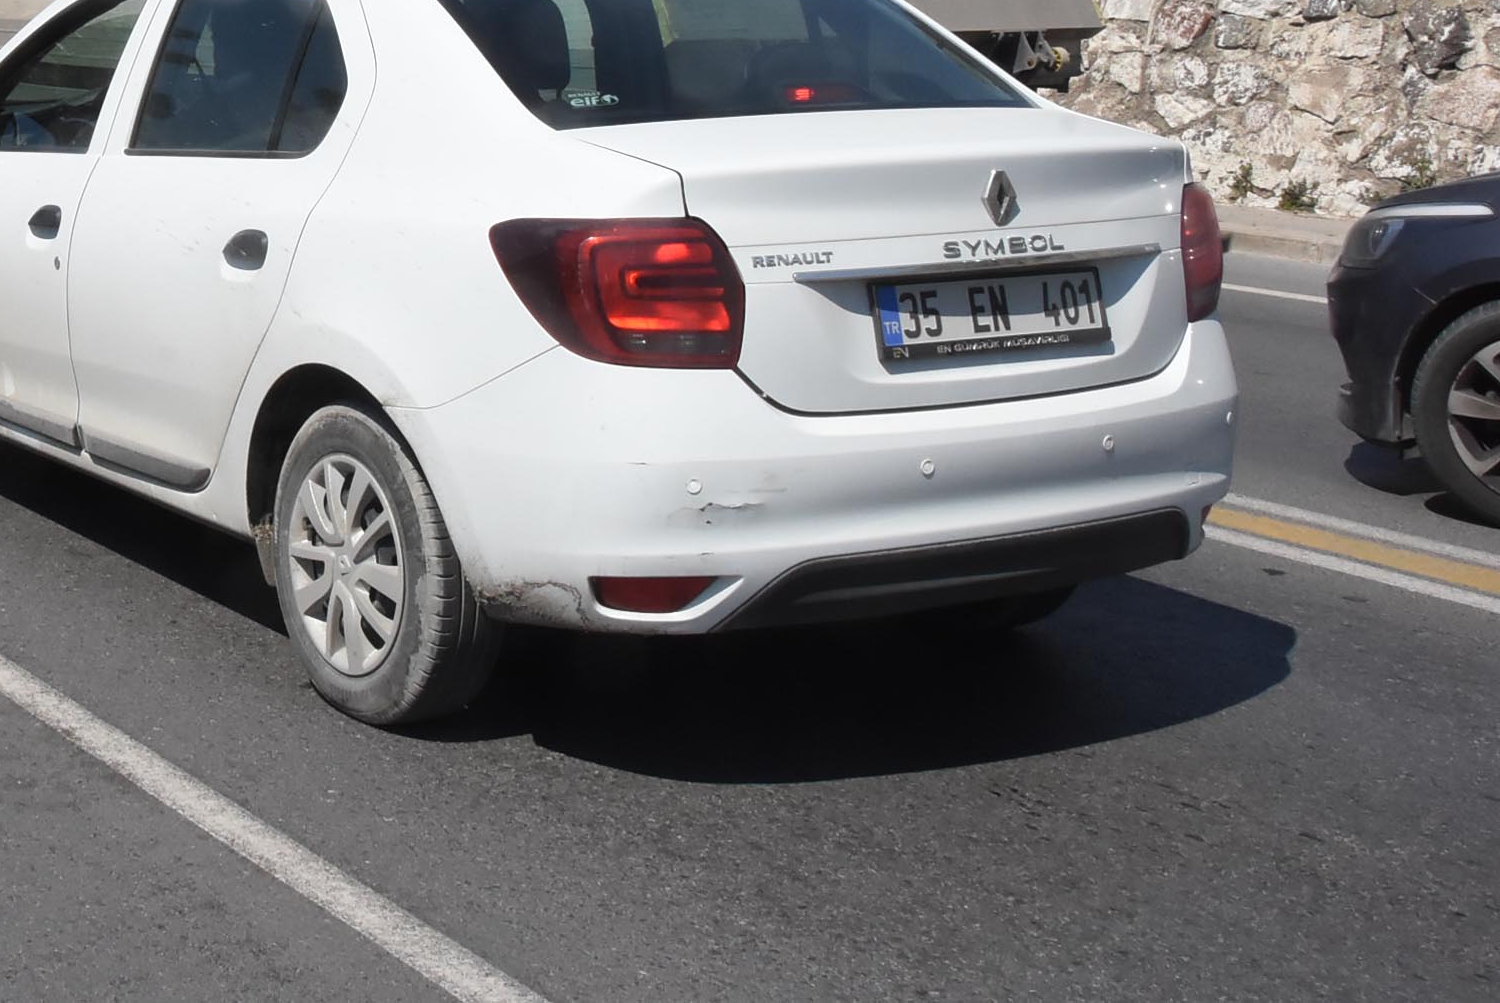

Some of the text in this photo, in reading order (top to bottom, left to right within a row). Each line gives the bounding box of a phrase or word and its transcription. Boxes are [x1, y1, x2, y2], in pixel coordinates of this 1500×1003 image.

[570, 97, 600, 107] elf
[942, 233, 1065, 259] SYMBOL
[752, 251, 833, 268] RENAULT
[884, 278, 1096, 339] TR 35 EN 401
[937, 344, 952, 355] EN
